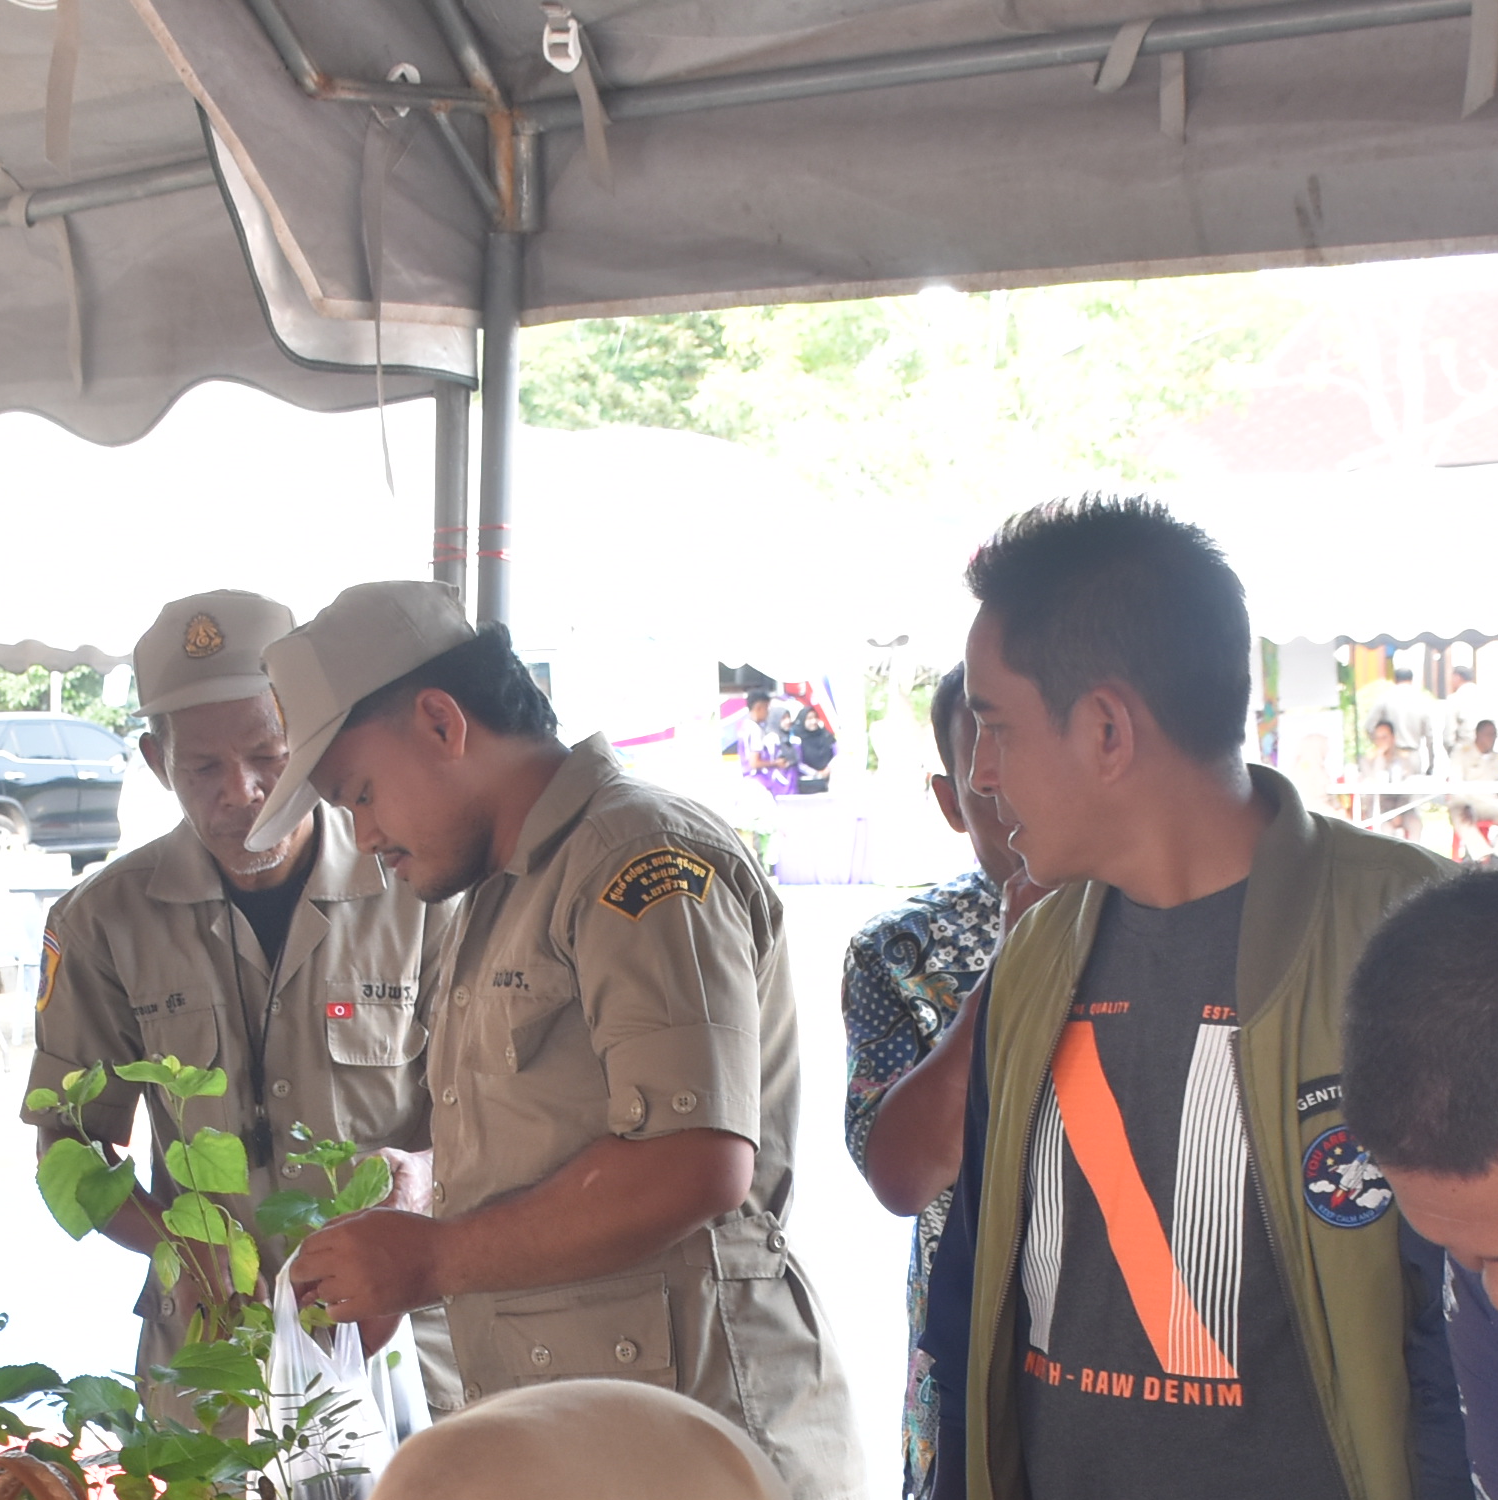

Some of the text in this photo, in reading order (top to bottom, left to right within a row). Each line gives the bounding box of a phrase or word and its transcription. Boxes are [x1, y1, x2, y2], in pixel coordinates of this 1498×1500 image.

[362, 982, 415, 1000] อปพร.
[1089, 1000, 1131, 1015] QUALITY
[1306, 1131, 1348, 1179] YOU ARE
[1317, 1204, 1336, 1219] KEEP
[1335, 1211, 1358, 1223] CALM
[1080, 1367, 1135, 1399] RAW
[1143, 1376, 1243, 1407] DENIM
